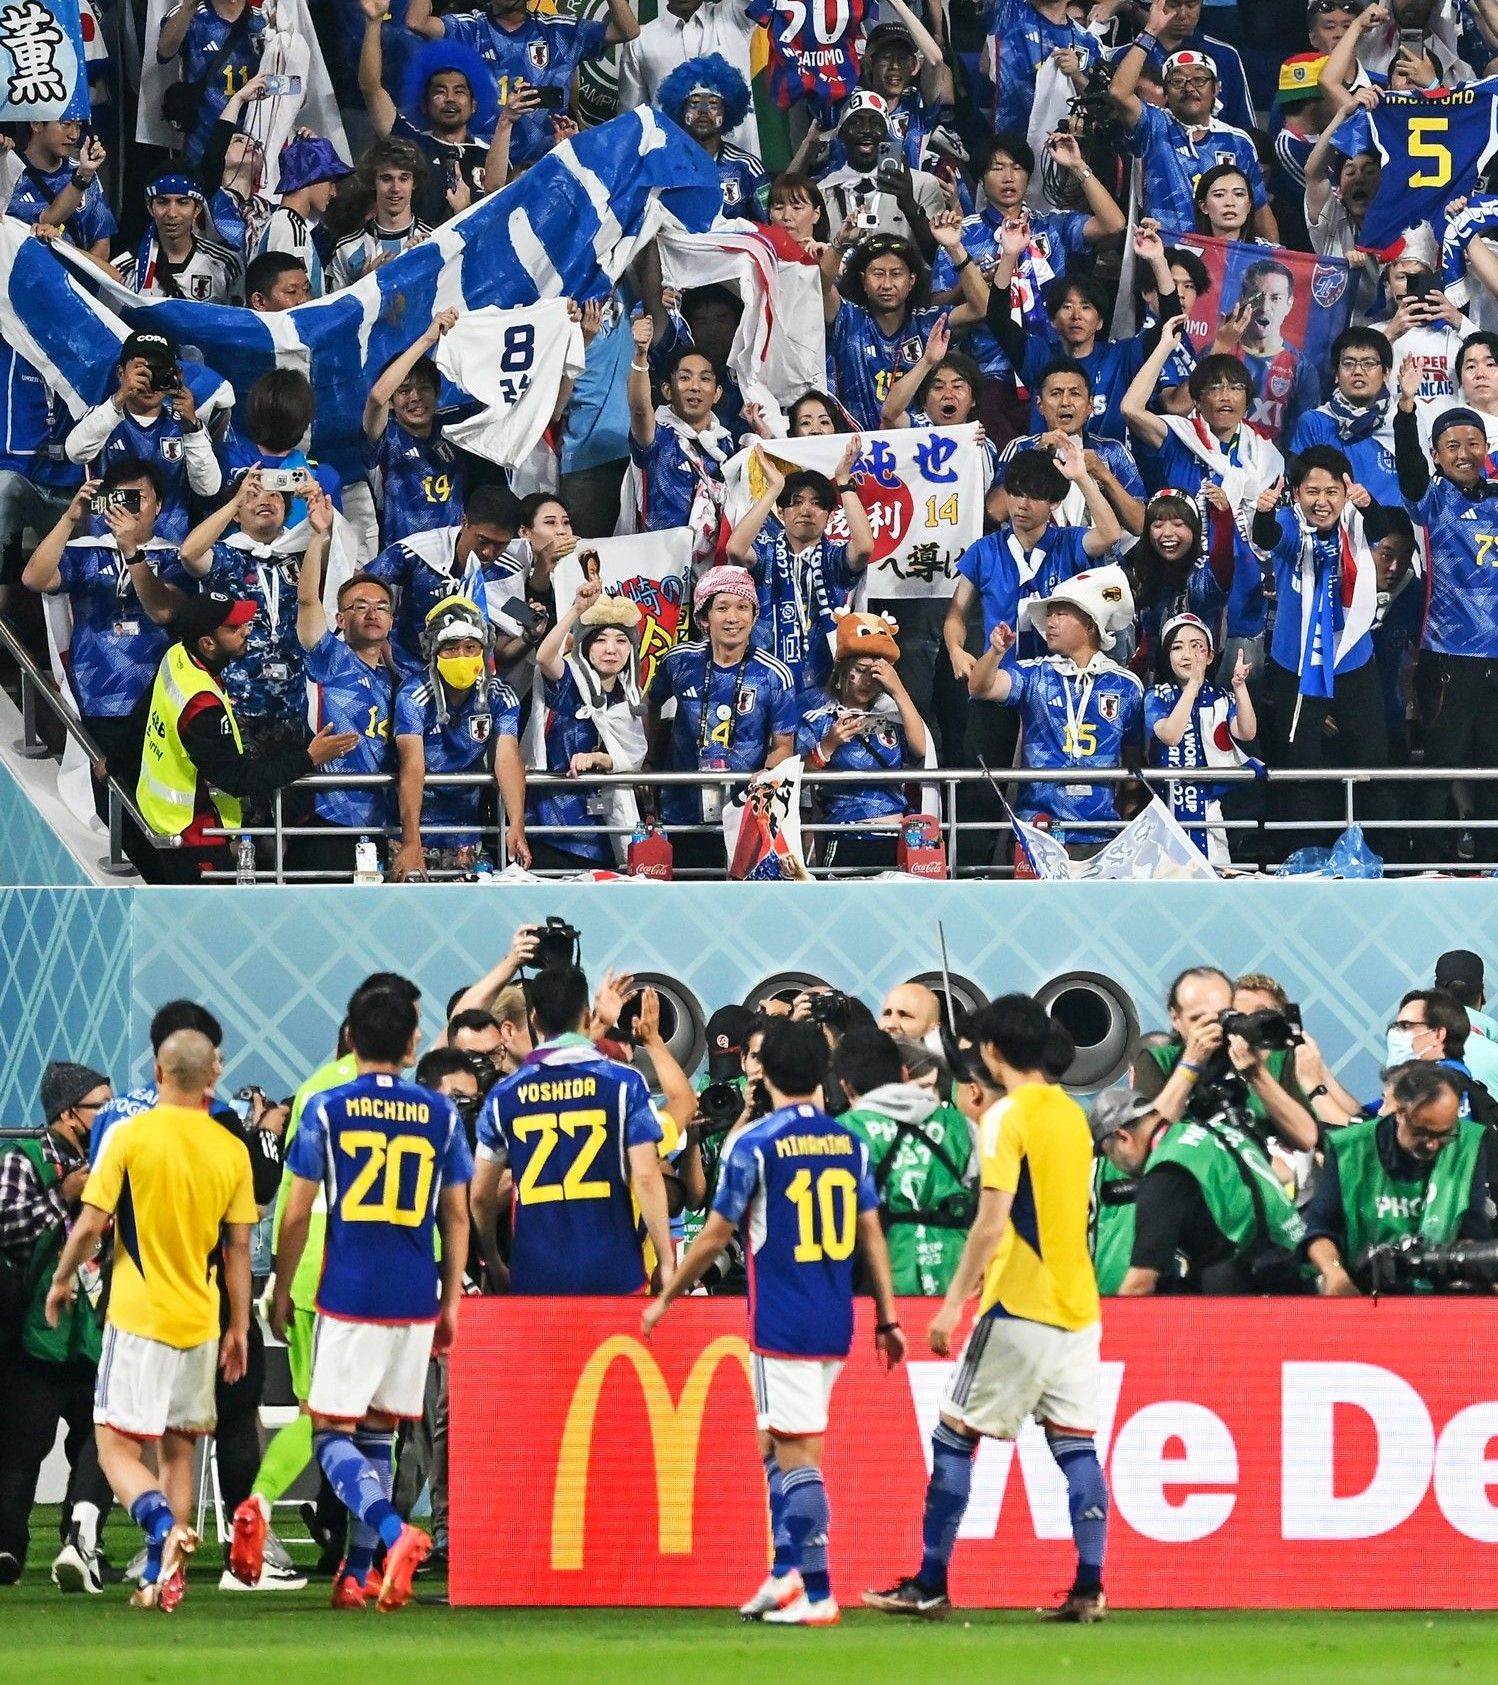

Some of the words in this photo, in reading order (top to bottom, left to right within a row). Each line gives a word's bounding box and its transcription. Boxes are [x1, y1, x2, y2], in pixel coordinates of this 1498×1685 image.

[2, 3, 66, 105] 薫
[782, 48, 844, 67] NGATOMO
[1408, 117, 1452, 188] 5
[137, 334, 169, 346] COPA
[502, 324, 535, 373] 8
[925, 493, 958, 527] 14
[1062, 723, 1097, 757] 15
[1185, 785, 1197, 813] CUP
[517, 1077, 596, 1104] YOSHIDA
[346, 1098, 429, 1125] MACHINO
[513, 1109, 611, 1206] 22
[776, 1134, 853, 1158] MINAMINO
[340, 1130, 436, 1227] 20
[786, 1168, 857, 1263] 10
